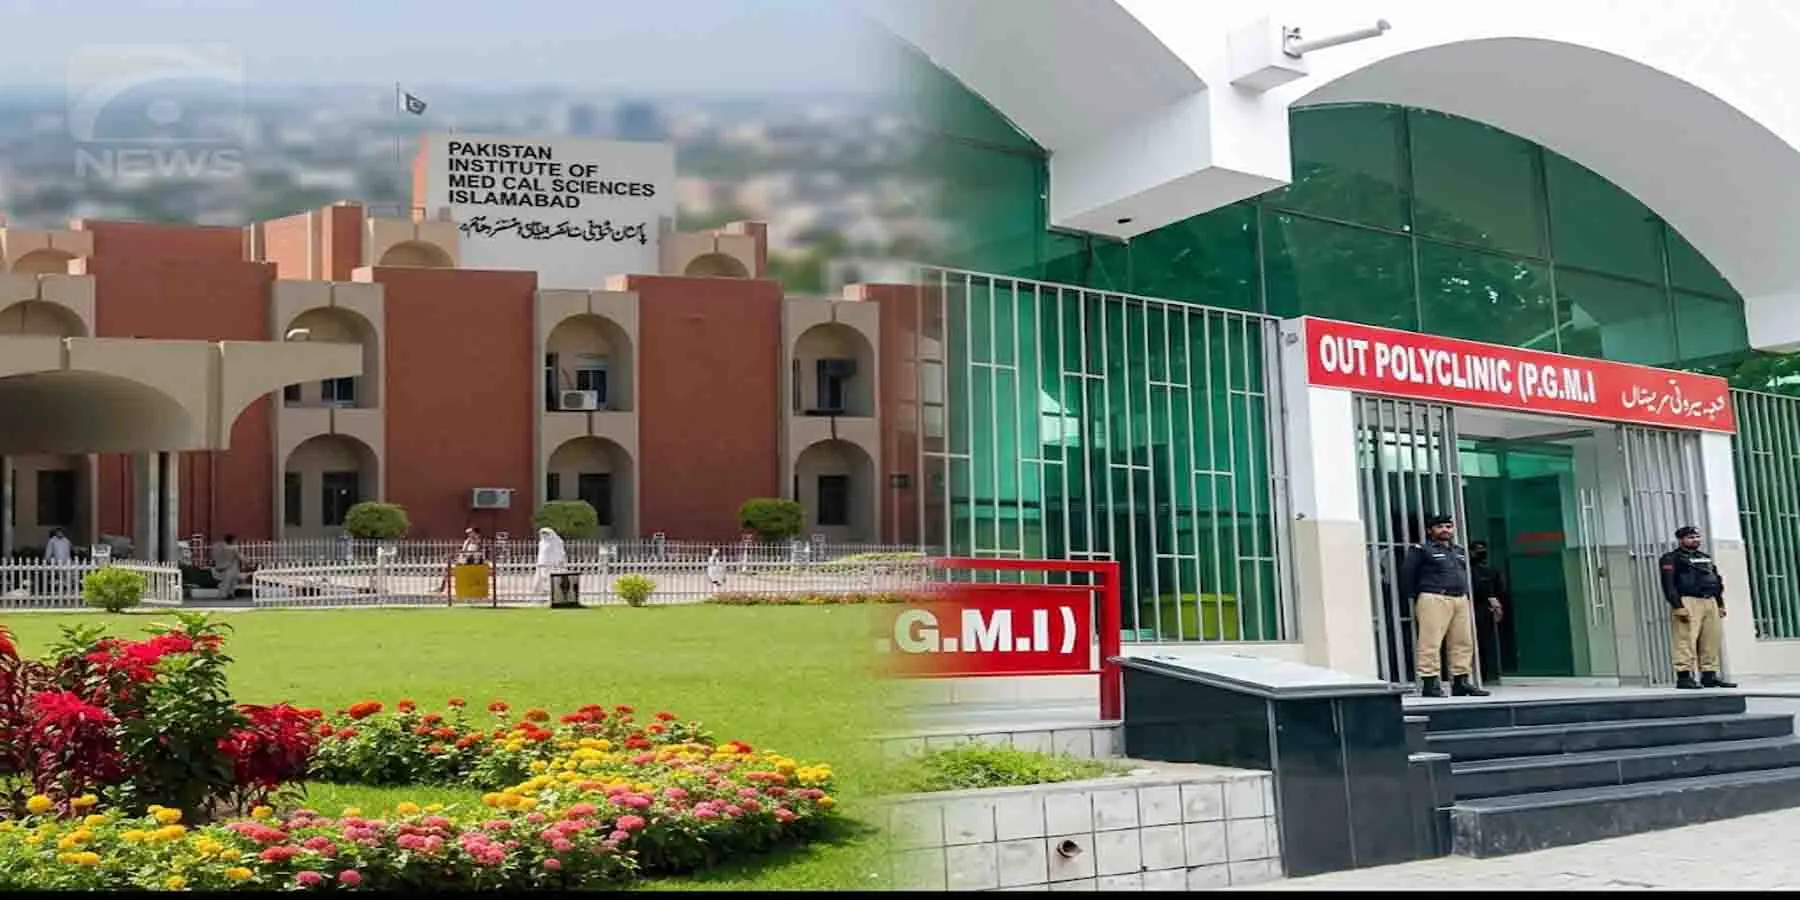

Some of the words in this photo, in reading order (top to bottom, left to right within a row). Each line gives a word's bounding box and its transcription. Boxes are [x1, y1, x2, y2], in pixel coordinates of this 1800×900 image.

[448, 141, 553, 160] PAKISTAN
[448, 159, 561, 177] INSTITUTE
[568, 163, 599, 178] OF
[551, 179, 656, 197] SCIENCES
[448, 190, 580, 209] ISLAMABAD
[1320, 334, 1369, 375] OUT
[1375, 339, 1512, 391] POLYCLINIC
